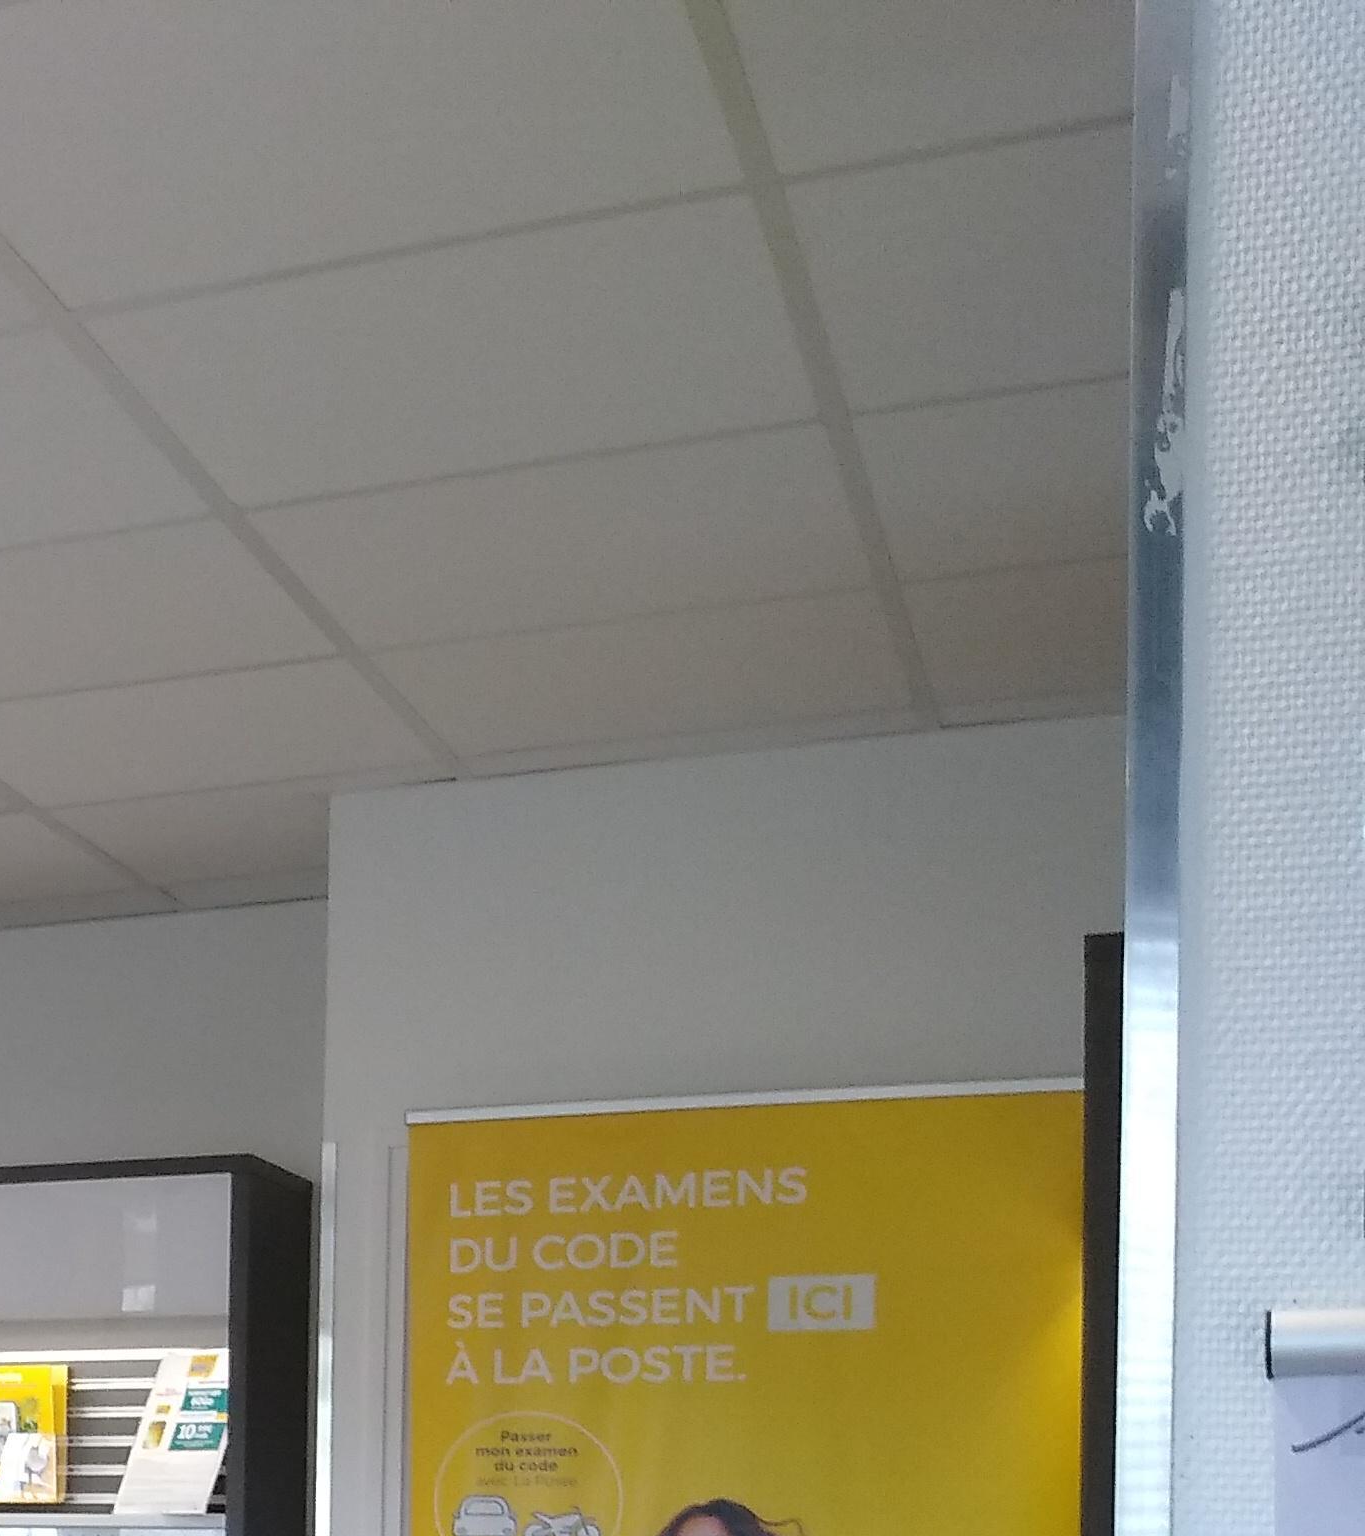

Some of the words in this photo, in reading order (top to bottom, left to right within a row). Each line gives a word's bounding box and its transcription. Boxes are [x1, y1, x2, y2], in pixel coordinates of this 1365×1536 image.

[449, 1179, 534, 1218] LES
[548, 1166, 808, 1214] EXAMENS
[449, 1237, 518, 1273] DU
[532, 1231, 679, 1271] CODE
[447, 1293, 505, 1330] SE
[520, 1285, 756, 1328] PASSENT
[786, 1284, 854, 1321] ICI
[446, 1343, 478, 1385] À
[494, 1350, 554, 1385] LA
[568, 1344, 747, 1384] POSTE.
[475, 1447, 511, 1458] mon
[514, 1447, 579, 1458] examen
[500, 1430, 552, 1443] Passer
[494, 1460, 515, 1472] du
[518, 1460, 559, 1472] code
